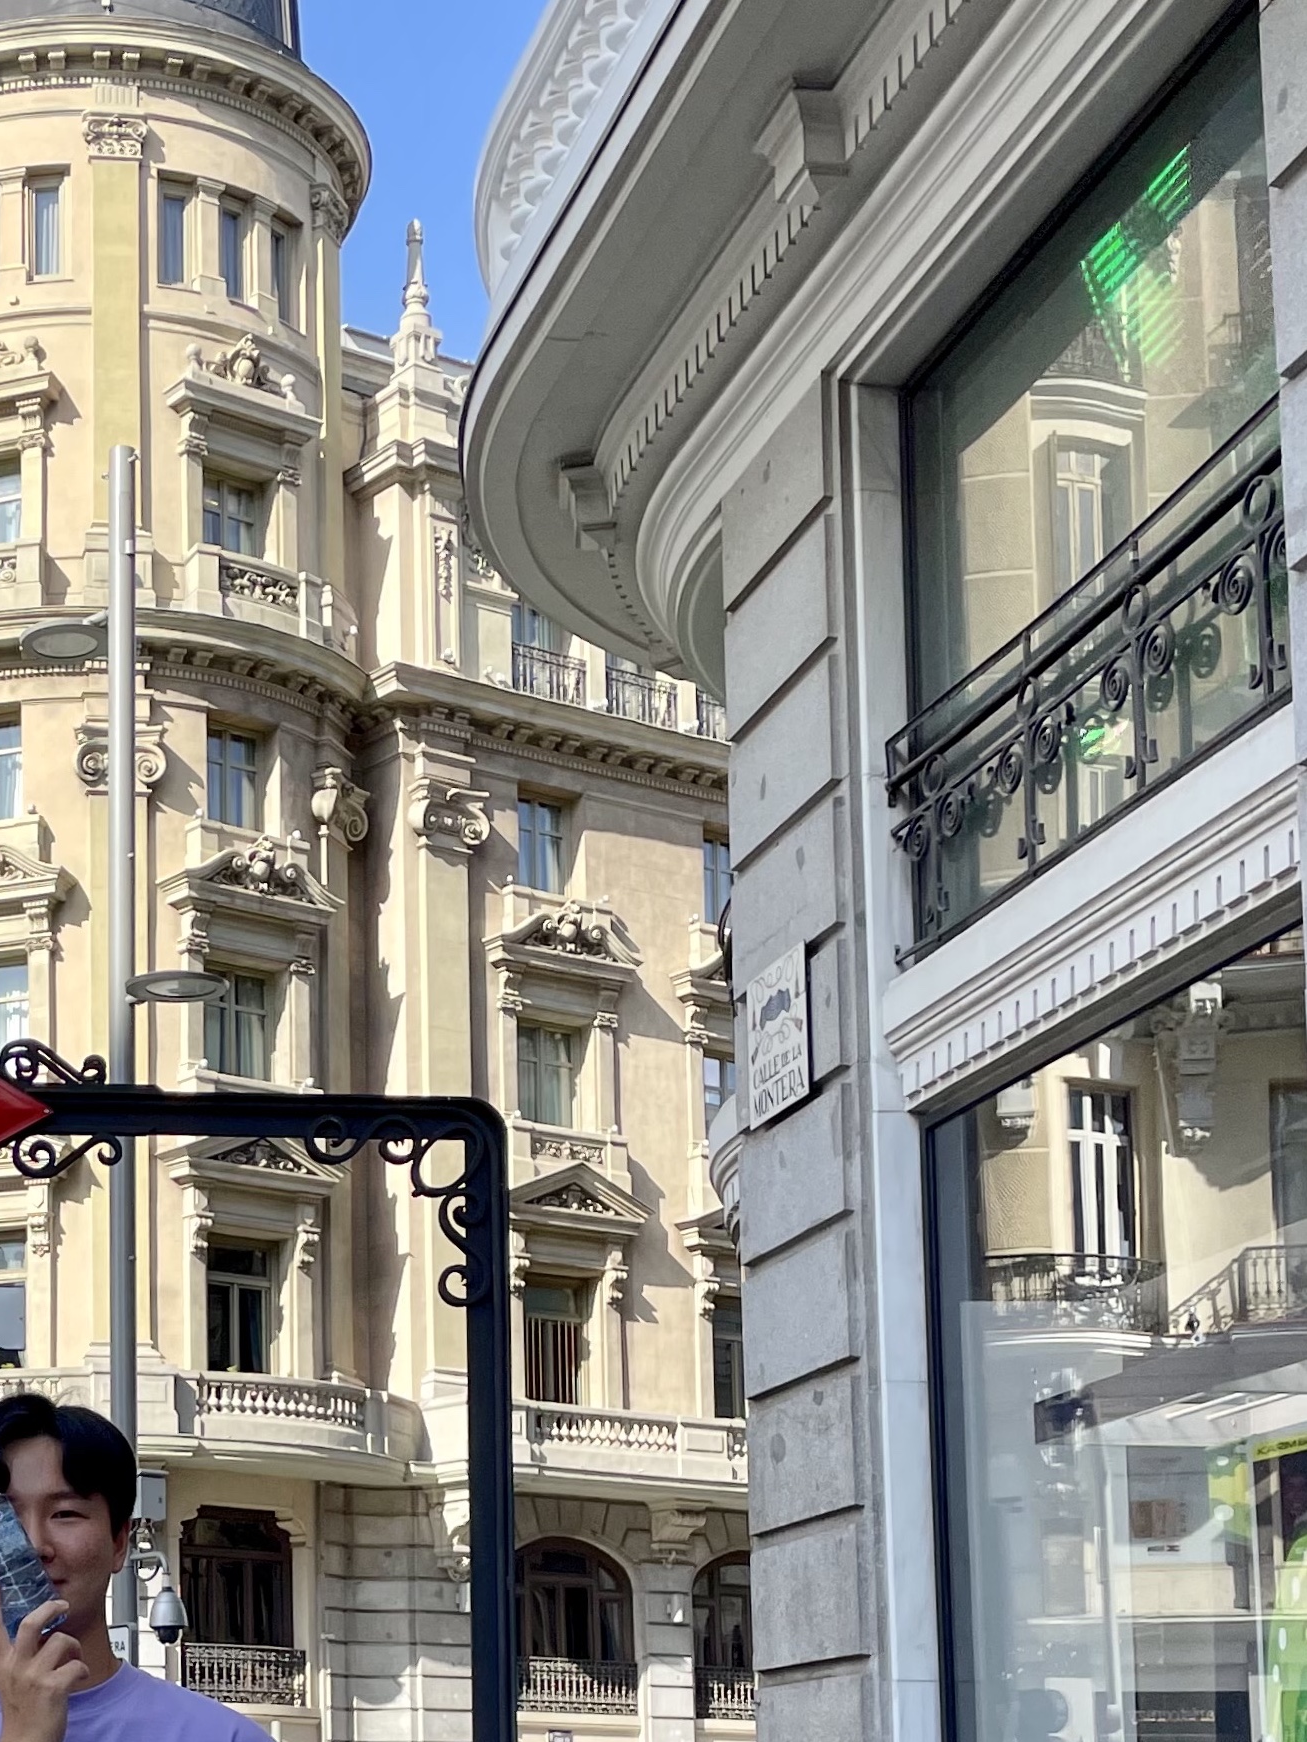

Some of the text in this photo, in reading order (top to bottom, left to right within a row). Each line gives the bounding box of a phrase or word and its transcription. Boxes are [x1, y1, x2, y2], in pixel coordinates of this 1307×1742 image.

[753, 1044, 802, 1089] CALLE DE LA
[754, 1066, 805, 1117] MONTERA
